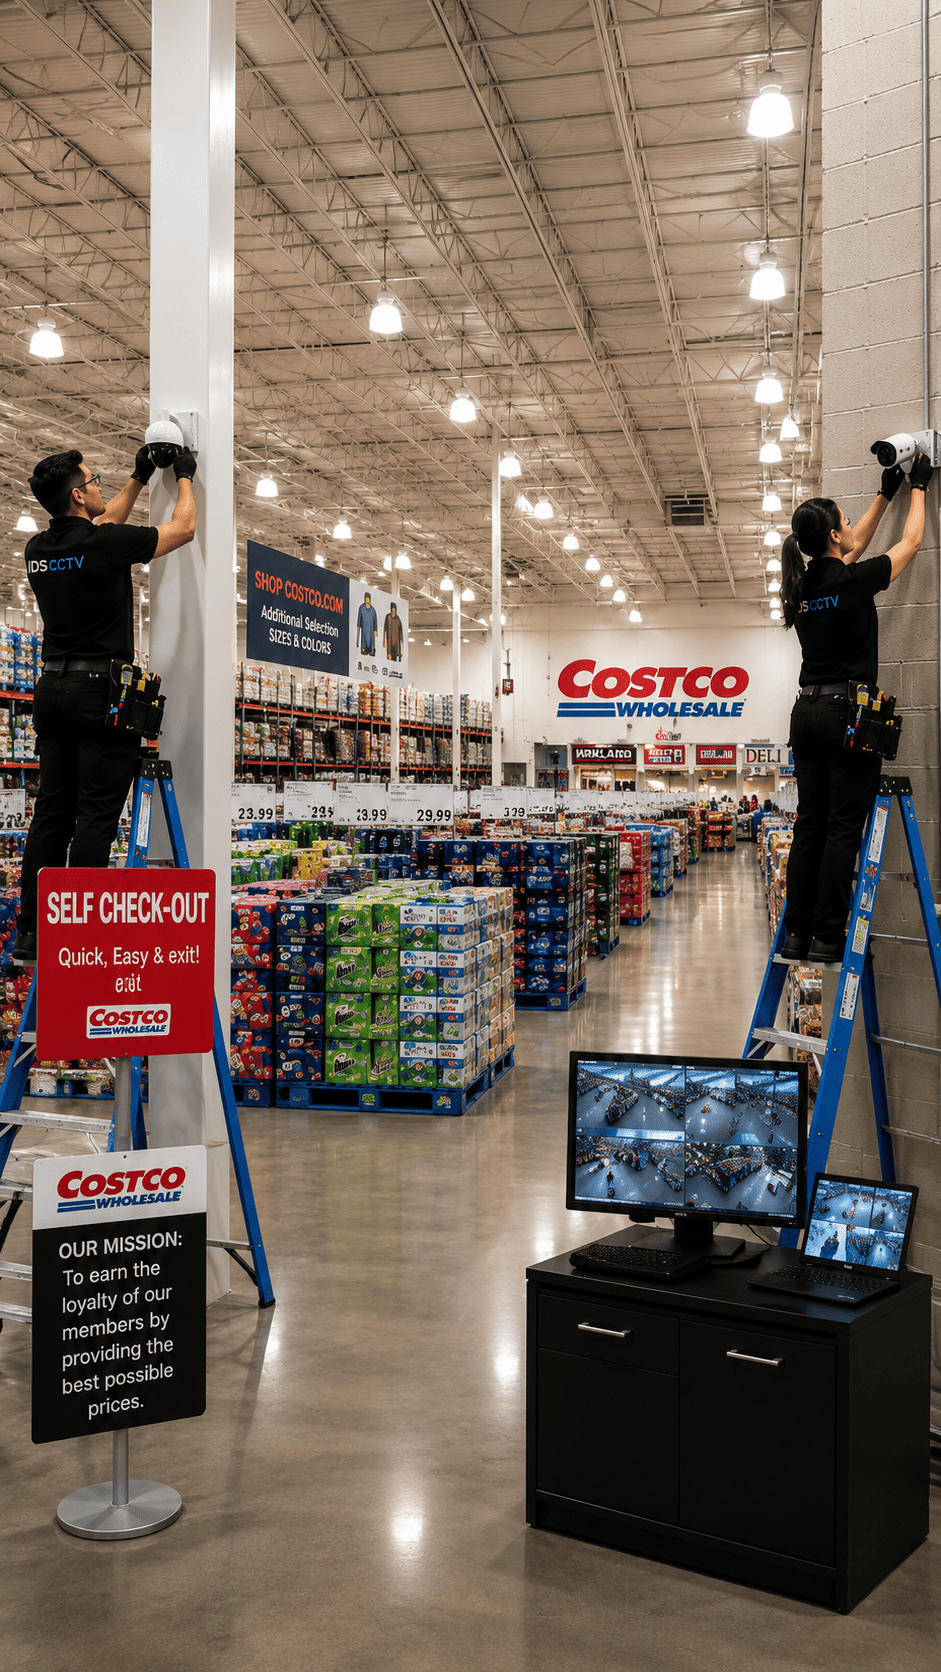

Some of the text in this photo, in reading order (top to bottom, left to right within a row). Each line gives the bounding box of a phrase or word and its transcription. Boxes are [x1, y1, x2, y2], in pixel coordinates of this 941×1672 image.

[254, 570, 344, 615] SHOP COSTCO.COM
[798, 594, 839, 613] SCCTV
[261, 605, 339, 638] Additional Selection
[269, 627, 332, 655] SIZES & COLORS
[557, 658, 750, 699] COSTCO
[616, 701, 745, 718] WHOLESALE
[238, 807, 274, 820] 23.99
[47, 892, 209, 924] SELF CHECK-OUT
[58, 945, 200, 969] Quick, Easy & exit!
[89, 1008, 169, 1026] COSTCO
[112, 1024, 167, 1035] WHOLESALE
[57, 1166, 186, 1199] COSTCO
[96, 1191, 182, 1209] WHOLESALE
[59, 1231, 183, 1259] OUR MISSION:
[63, 1261, 161, 1286] To earn the
[62, 1286, 172, 1316] loyalty of our
[62, 1312, 170, 1341] members by
[62, 1338, 174, 1372] providing the
[62, 1363, 174, 1395] best possible
[88, 1395, 144, 1420] prices.
